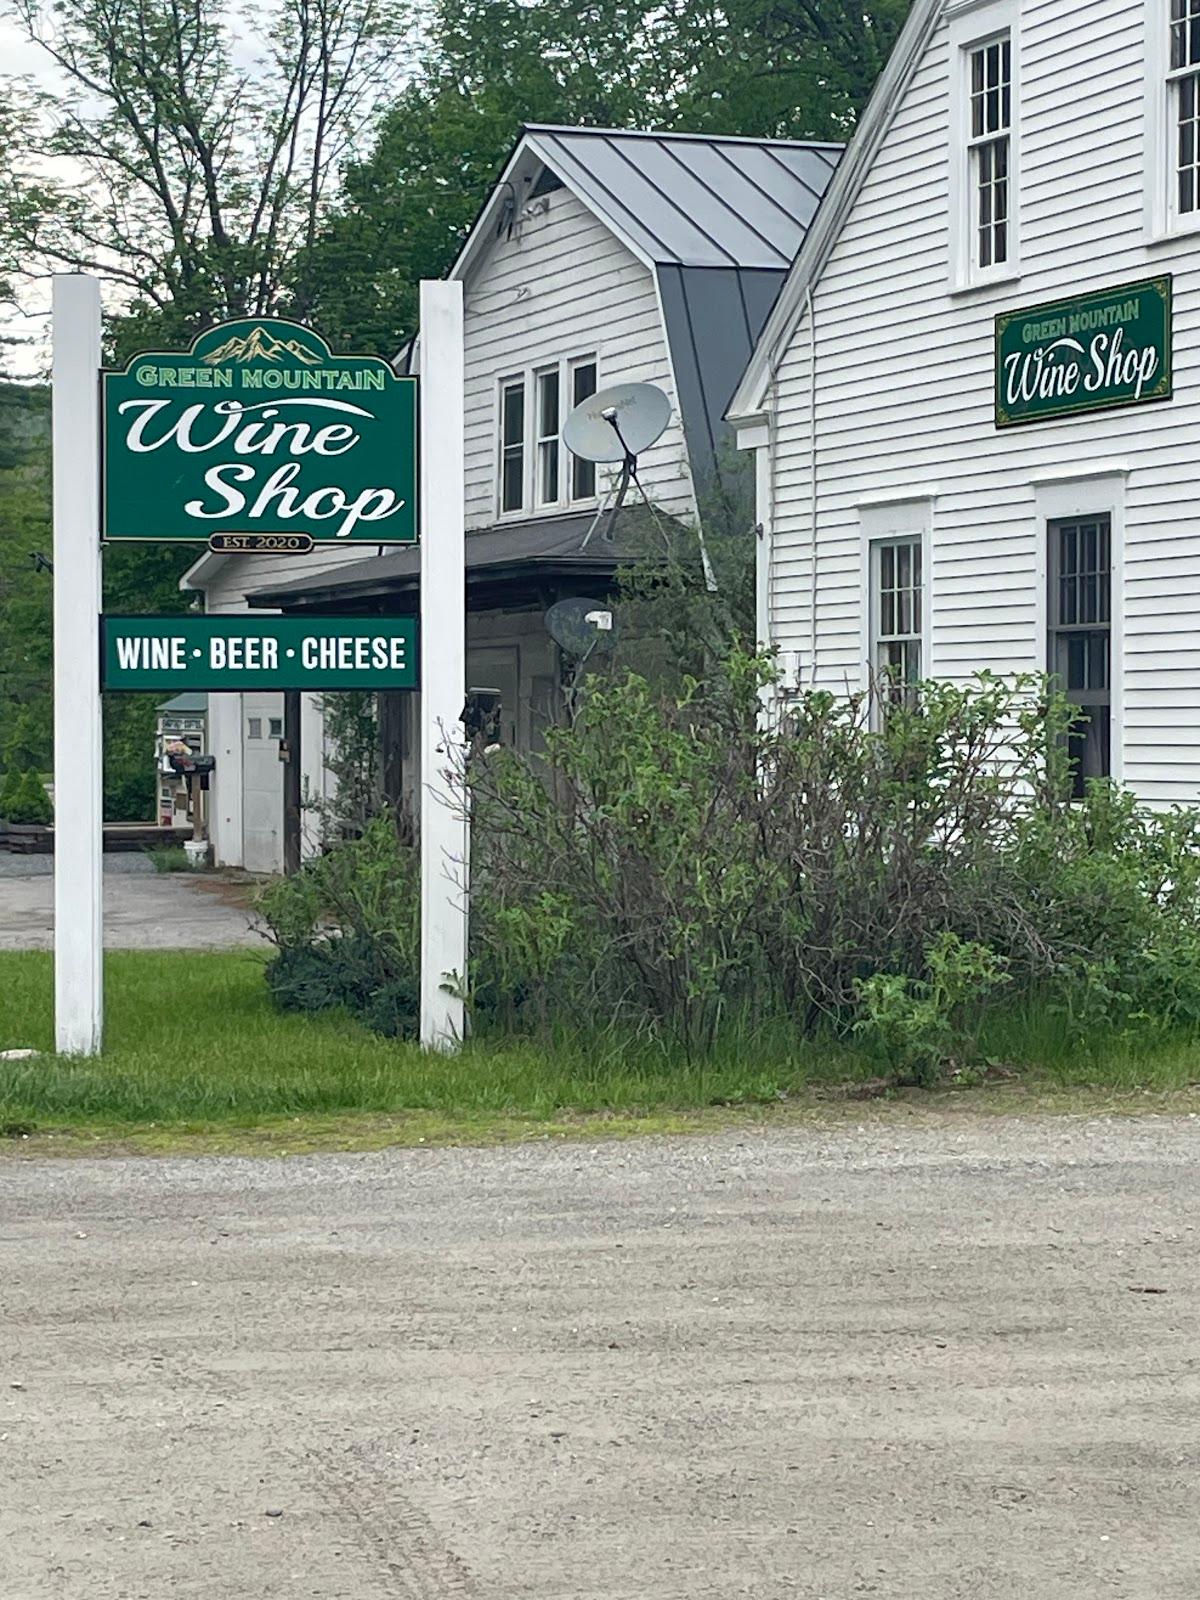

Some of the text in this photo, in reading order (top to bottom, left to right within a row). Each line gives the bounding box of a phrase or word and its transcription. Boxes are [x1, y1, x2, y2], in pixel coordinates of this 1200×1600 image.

[1022, 298, 1140, 343] GREEN MOUNTAIN
[136, 366, 385, 391] GREEN MOUNTAIN
[1004, 327, 1159, 405] Wine Shop
[118, 397, 375, 455] Wine
[184, 463, 405, 536] Shop
[256, 537, 300, 548] 2020
[116, 637, 406, 670] WINE BEER CHEESE
